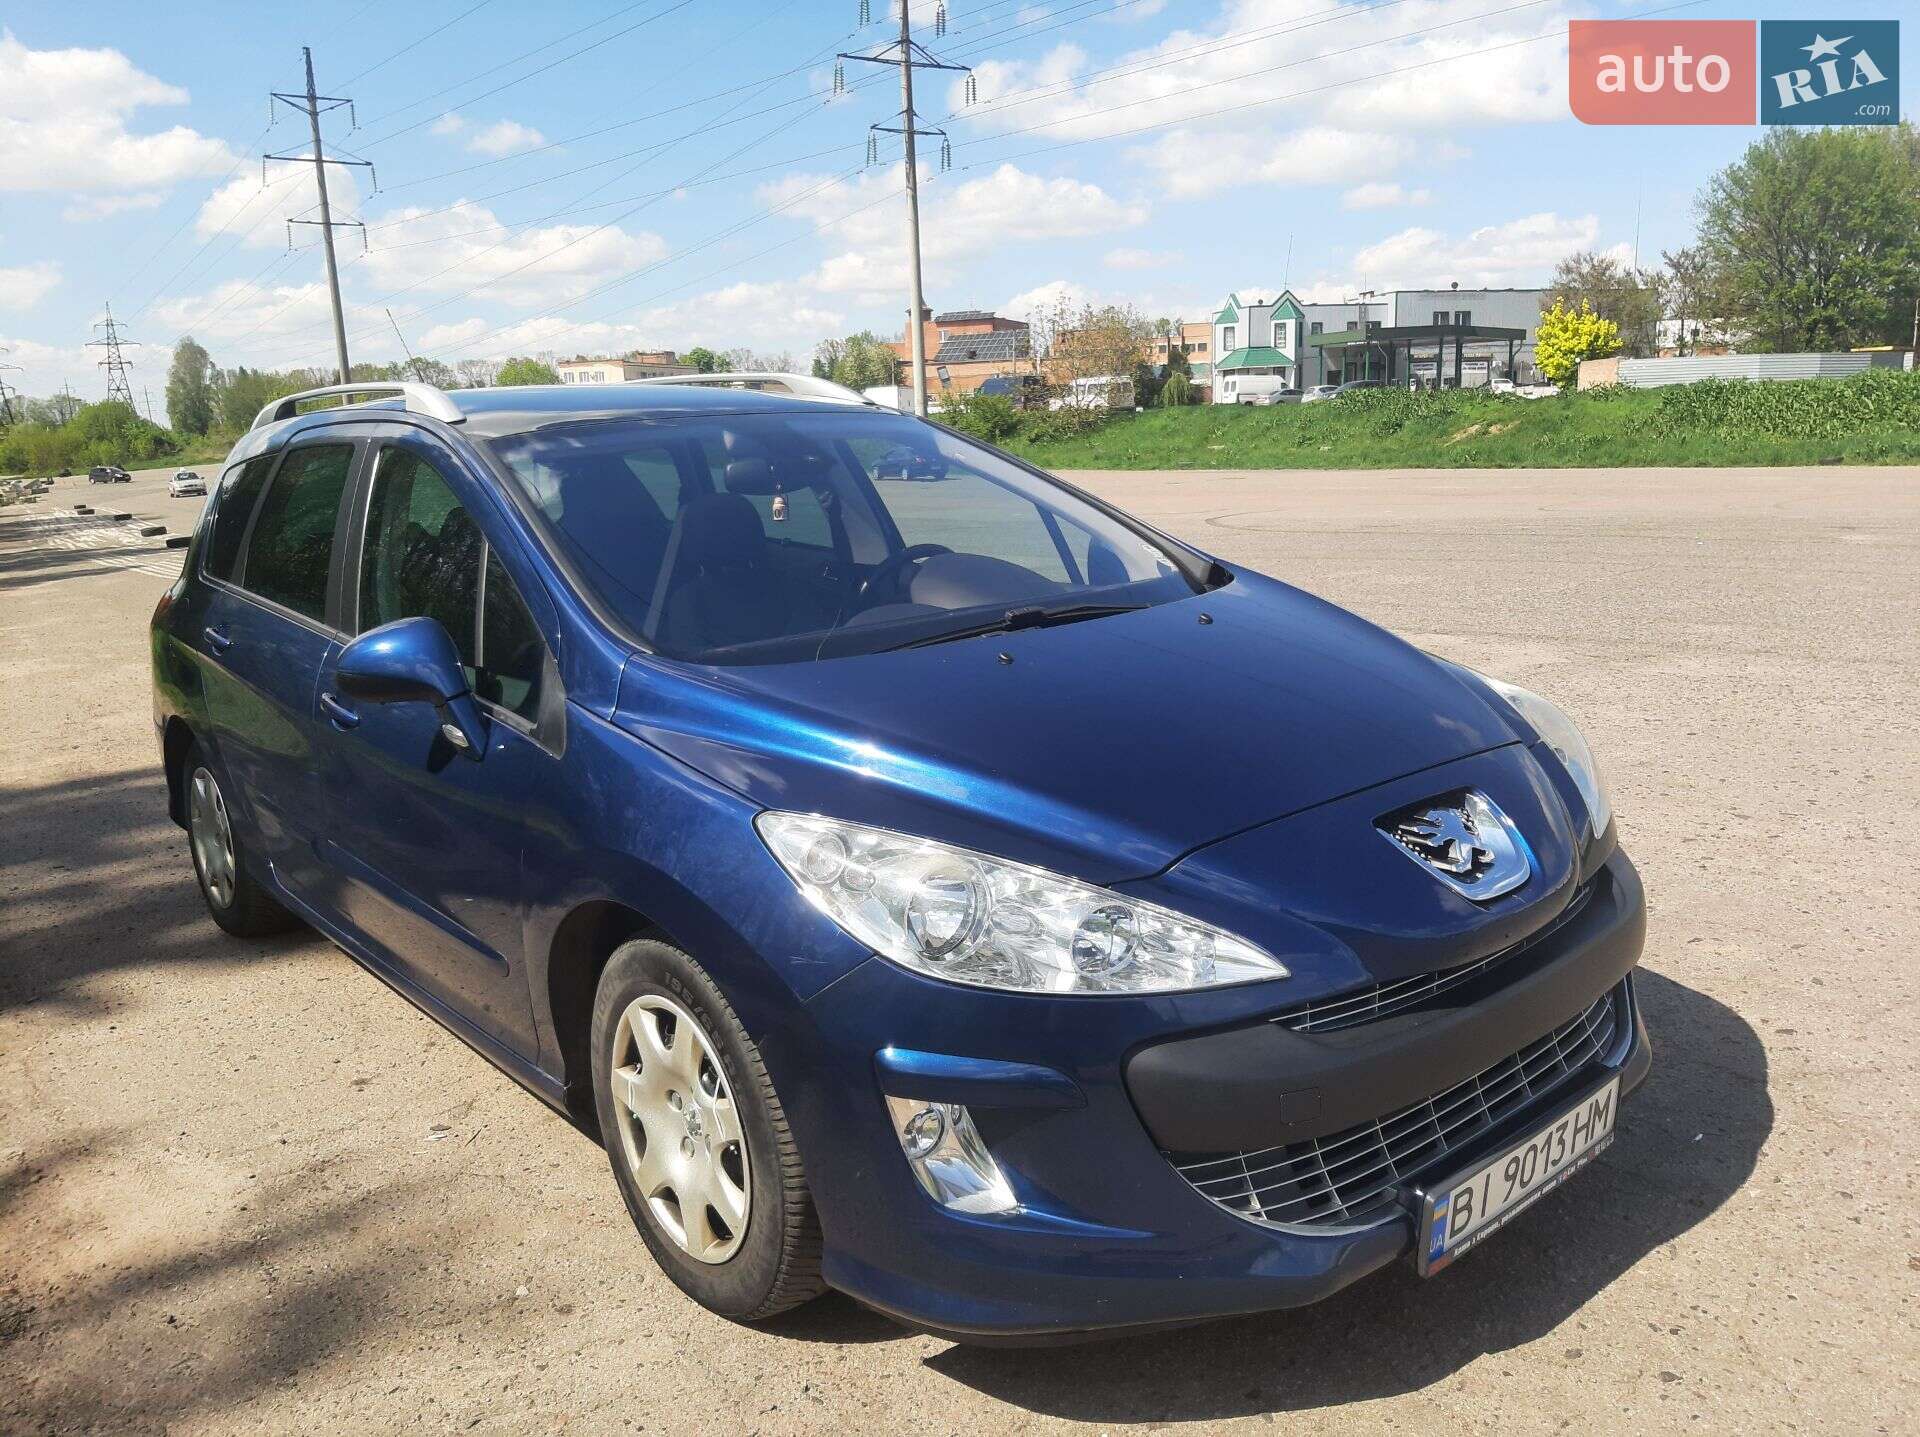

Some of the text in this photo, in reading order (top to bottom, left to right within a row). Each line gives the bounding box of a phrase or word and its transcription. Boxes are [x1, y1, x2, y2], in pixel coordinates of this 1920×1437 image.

[1449, 1173, 1490, 1240] BI
[1502, 1119, 1570, 1204] 9013
[1570, 1088, 1613, 1156] HM
[1429, 1233, 1443, 1253] UA
